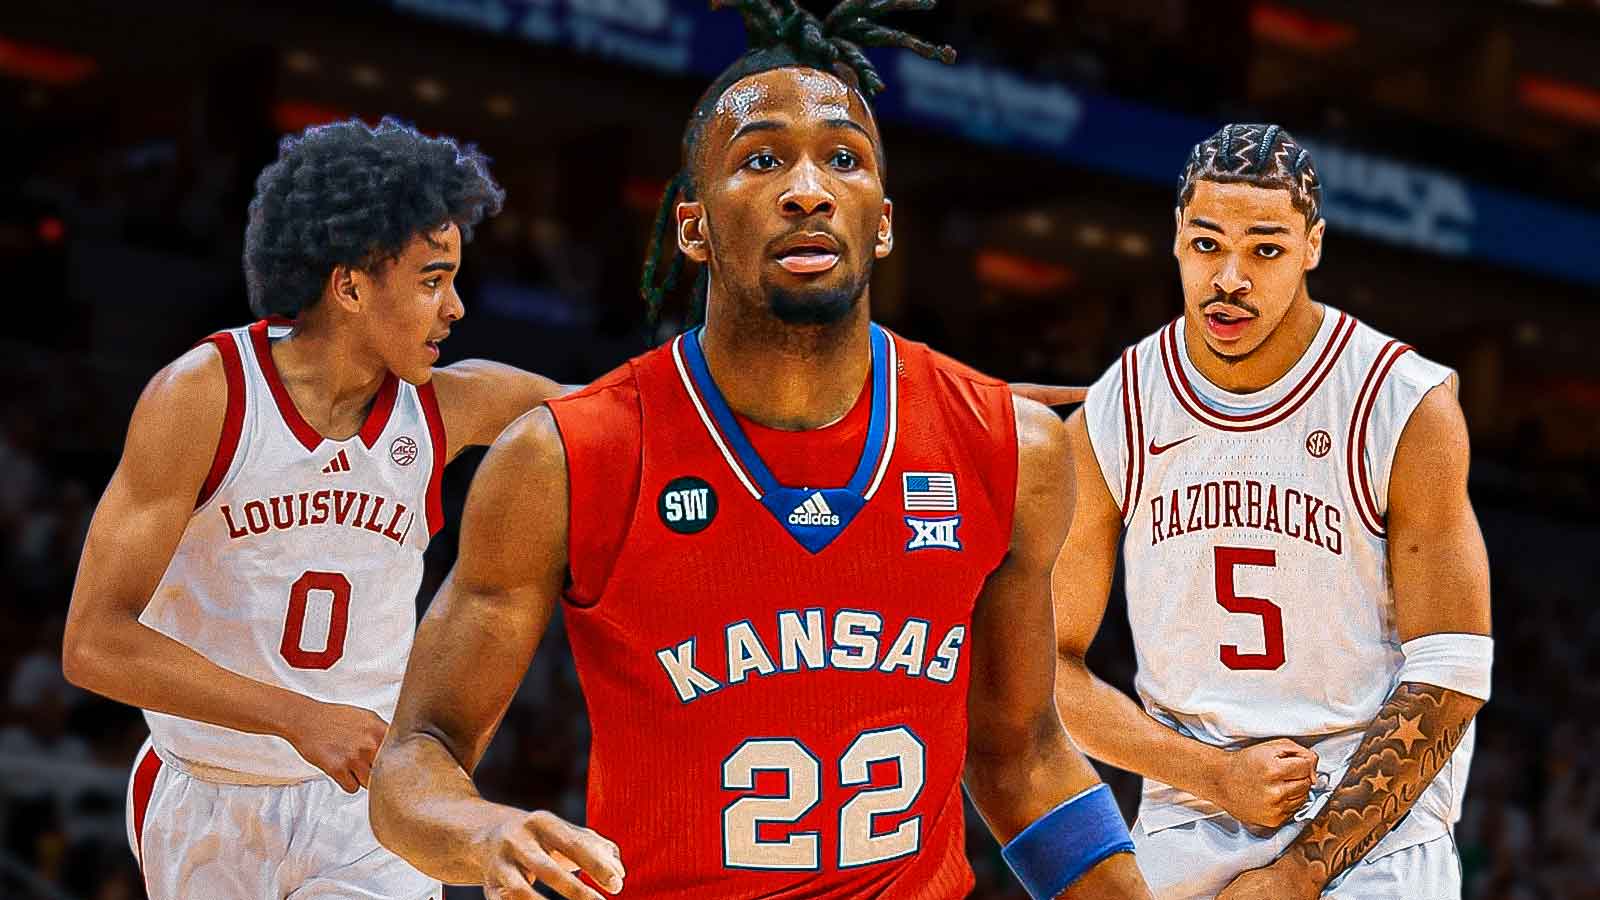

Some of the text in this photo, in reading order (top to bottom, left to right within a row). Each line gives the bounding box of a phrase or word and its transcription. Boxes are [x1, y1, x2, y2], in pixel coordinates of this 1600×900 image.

[1308, 432, 1330, 456] SEC
[220, 489, 414, 546] LOUISVILL
[665, 488, 709, 521] SW
[788, 512, 840, 526] adidas
[906, 516, 961, 550] XII
[1151, 480, 1342, 555] RAZORBACKS
[279, 570, 352, 670] 0
[1214, 546, 1286, 671] 5
[656, 608, 966, 703] KANSAS
[720, 724, 927, 872] 22
